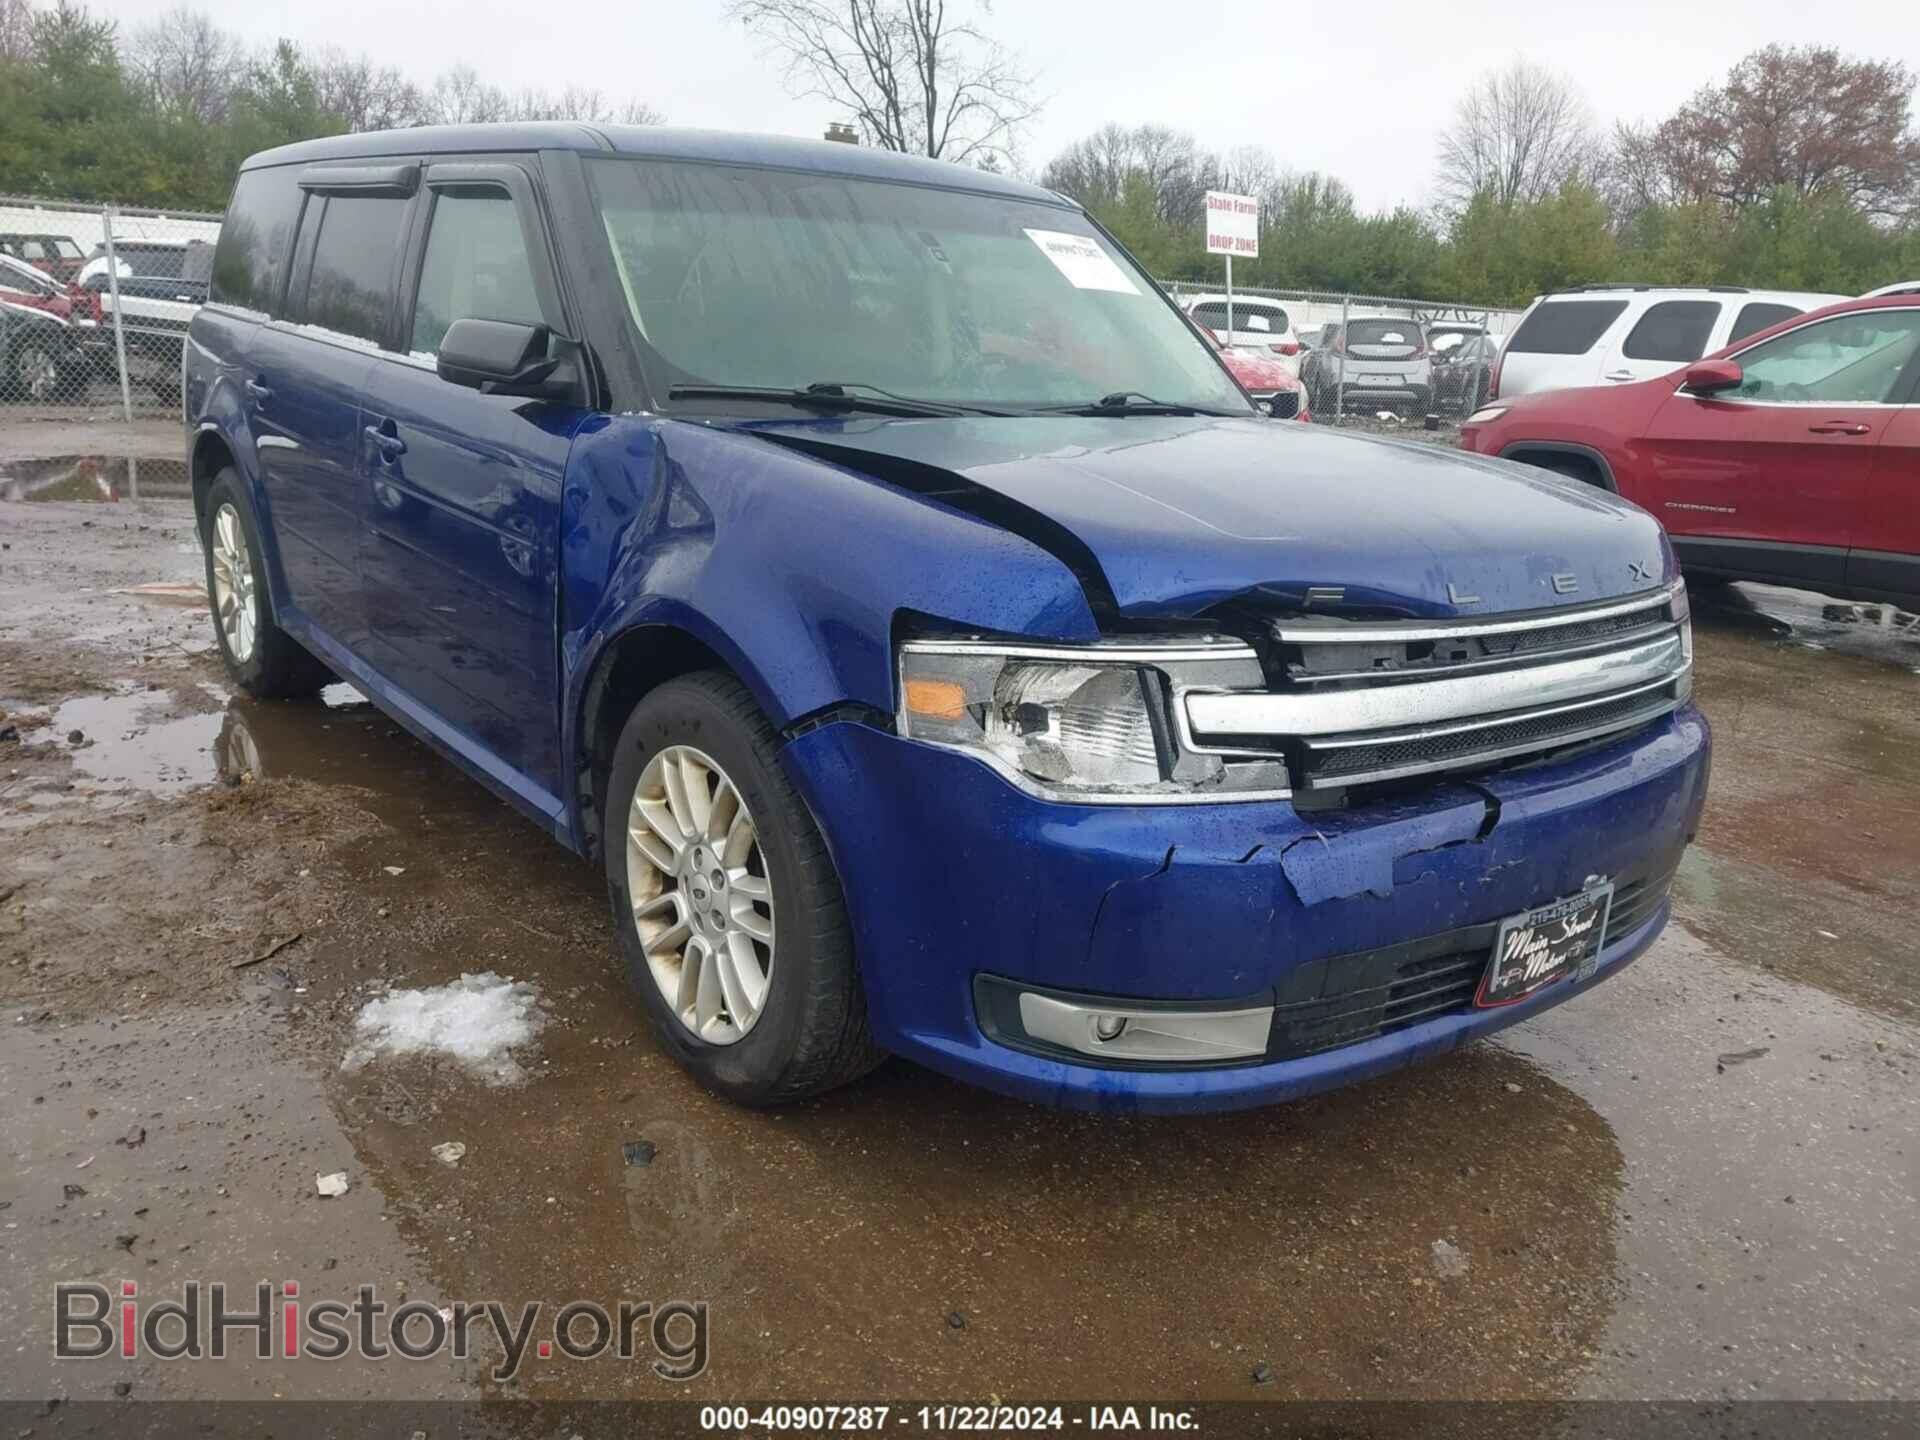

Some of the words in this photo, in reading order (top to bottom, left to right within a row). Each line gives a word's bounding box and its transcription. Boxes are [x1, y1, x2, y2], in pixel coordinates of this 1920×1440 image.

[1208, 196, 1232, 211] State
[1234, 200, 1257, 215] Farm
[1209, 234, 1233, 249] DROP
[1235, 238, 1257, 252] ZONE
[1664, 501, 1737, 513] CHEROKEE
[1503, 928, 1549, 962] Main
